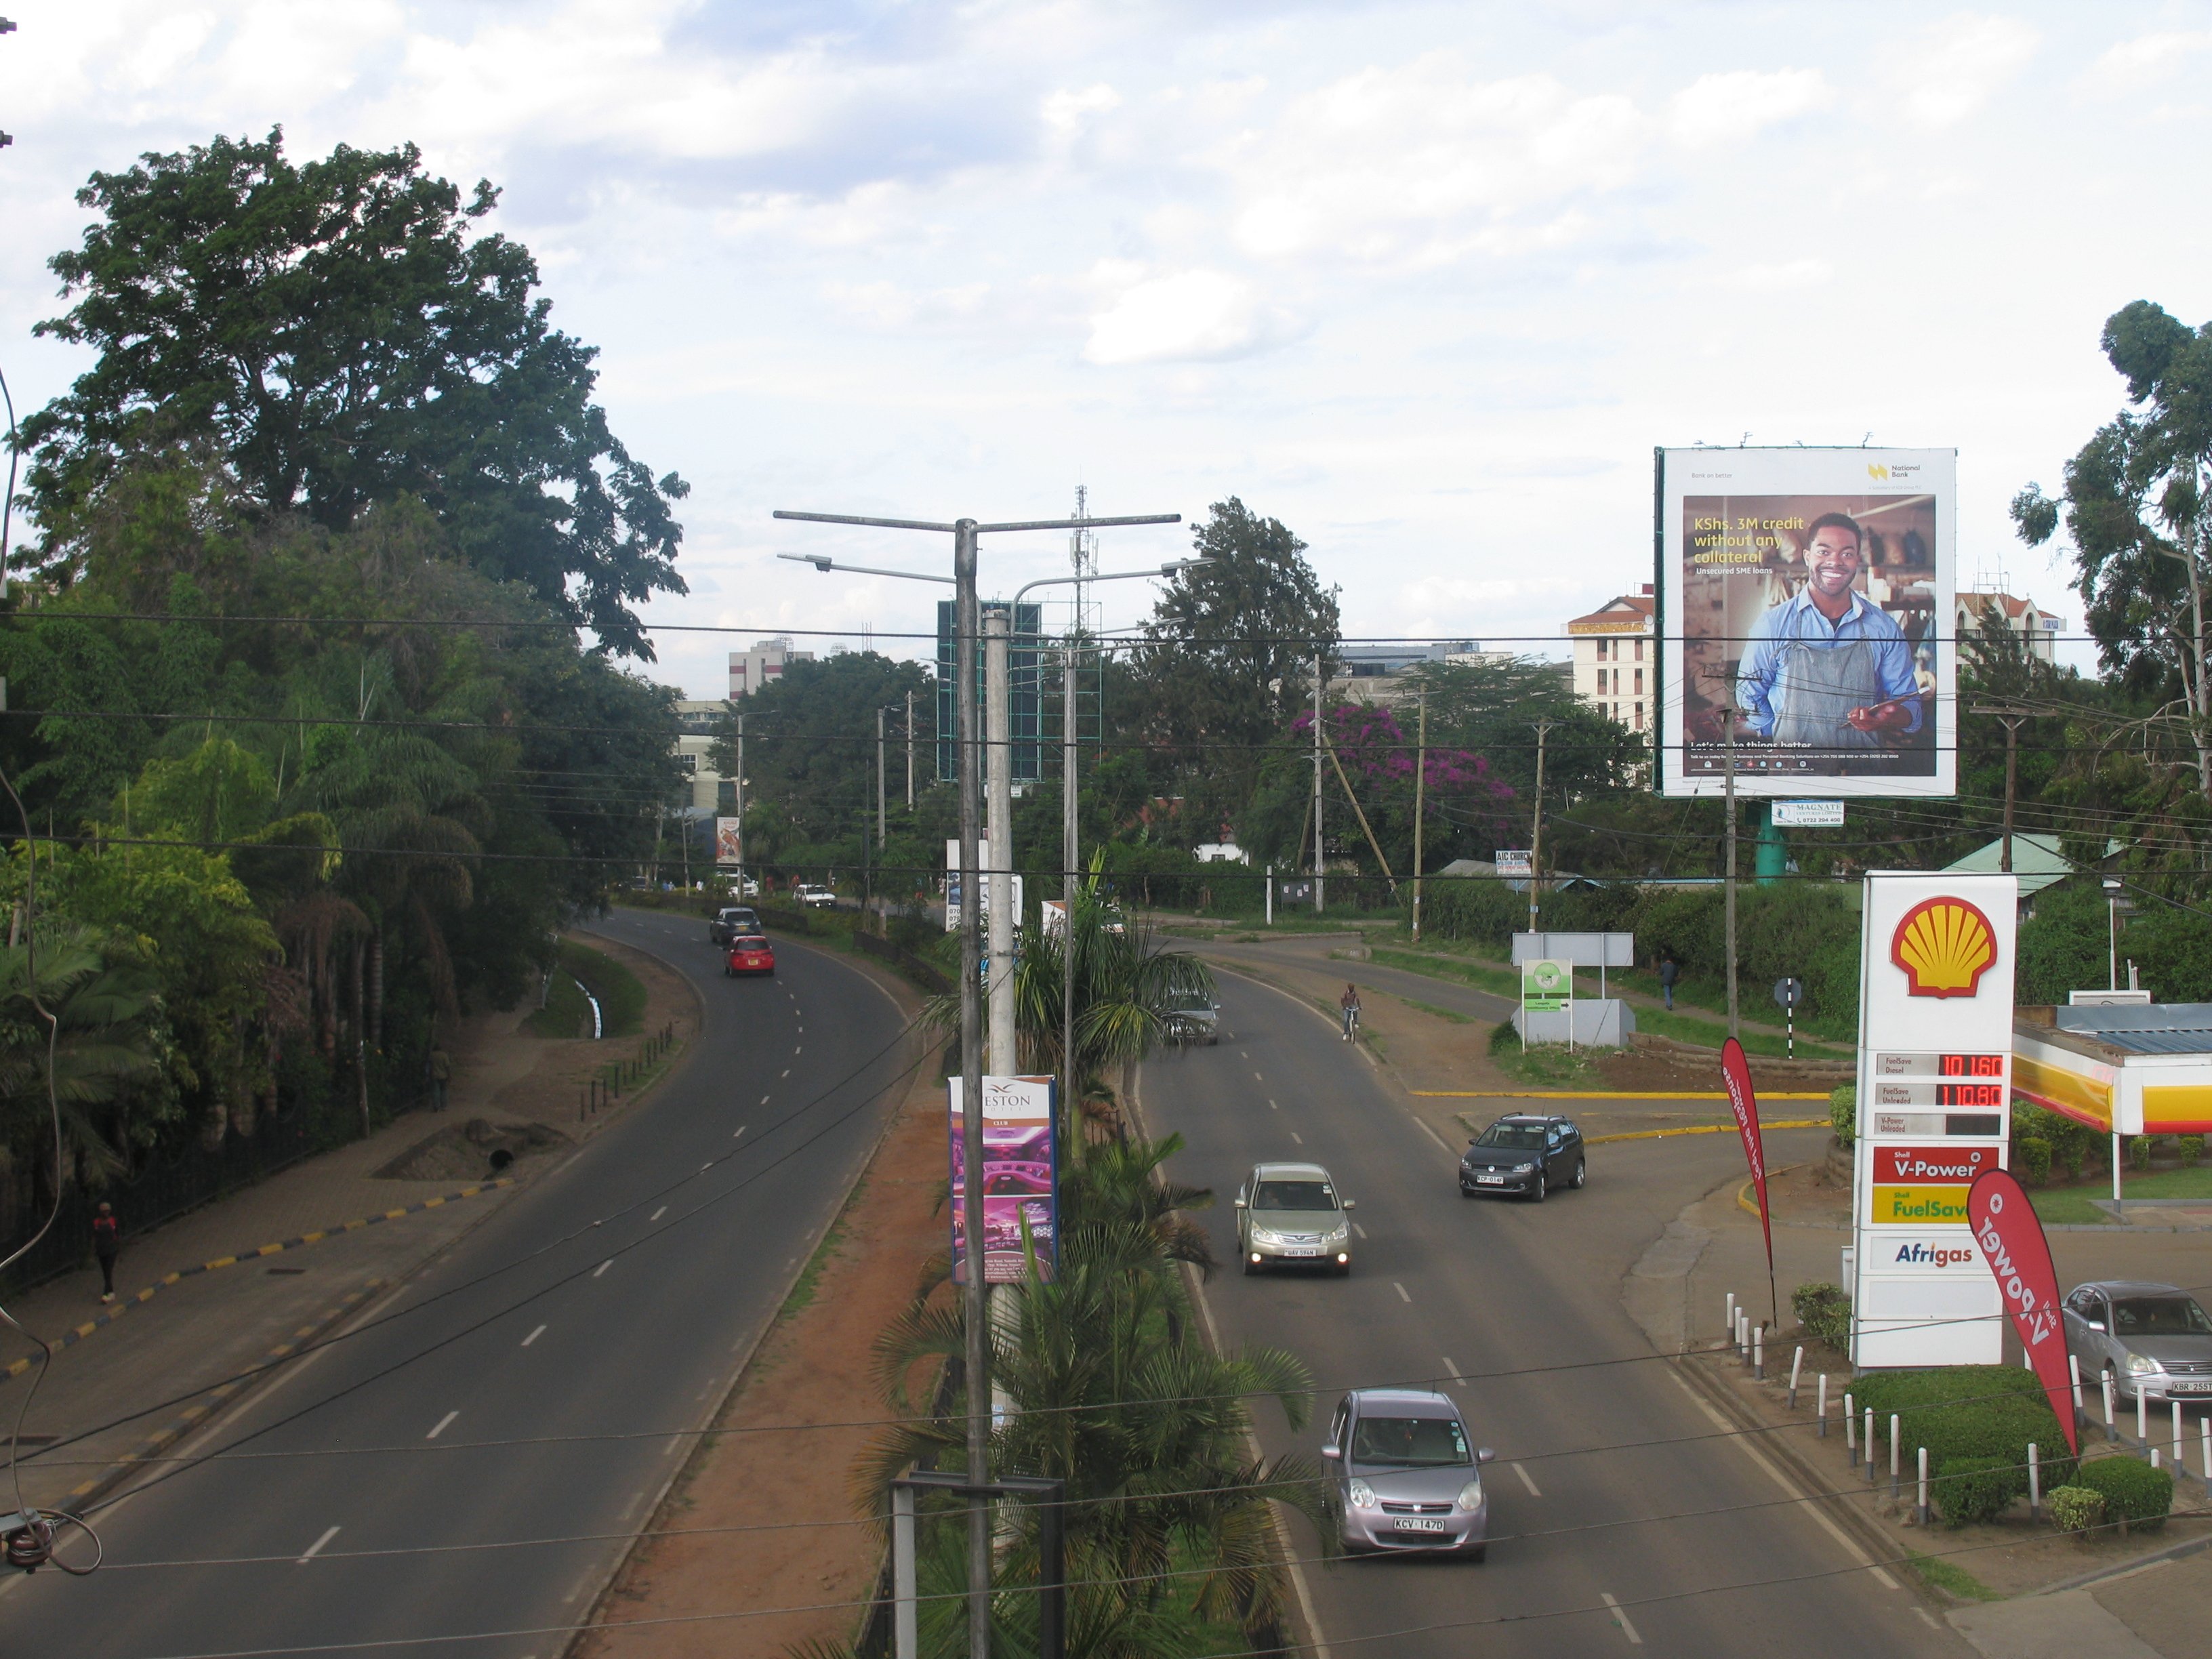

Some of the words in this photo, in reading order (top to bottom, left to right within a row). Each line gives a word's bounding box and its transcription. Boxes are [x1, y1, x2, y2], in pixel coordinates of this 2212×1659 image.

[1695, 517, 1733, 530] KShs.
[1737, 518, 1758, 530] 3M
[1762, 517, 1804, 530] credit
[1695, 534, 1752, 547] without
[1756, 536, 1783, 549] any
[1695, 550, 1762, 564] collateral
[1717, 741, 1744, 751] mke
[1746, 741, 1778, 752] things
[1781, 741, 1812, 751] better
[1497, 852, 1509, 860] AIC
[1944, 1055, 2003, 1077] 101.60
[983, 1095, 1030, 1106] ESTON
[1943, 1086, 2002, 1107] 110.80
[1895, 1160, 1977, 1177] V-Power
[1893, 1201, 1969, 1217] FuelSav
[1896, 1242, 1972, 1268] Afrigas
[1395, 1519, 1413, 1529] KCV
[1420, 1519, 1443, 1530] 147D
